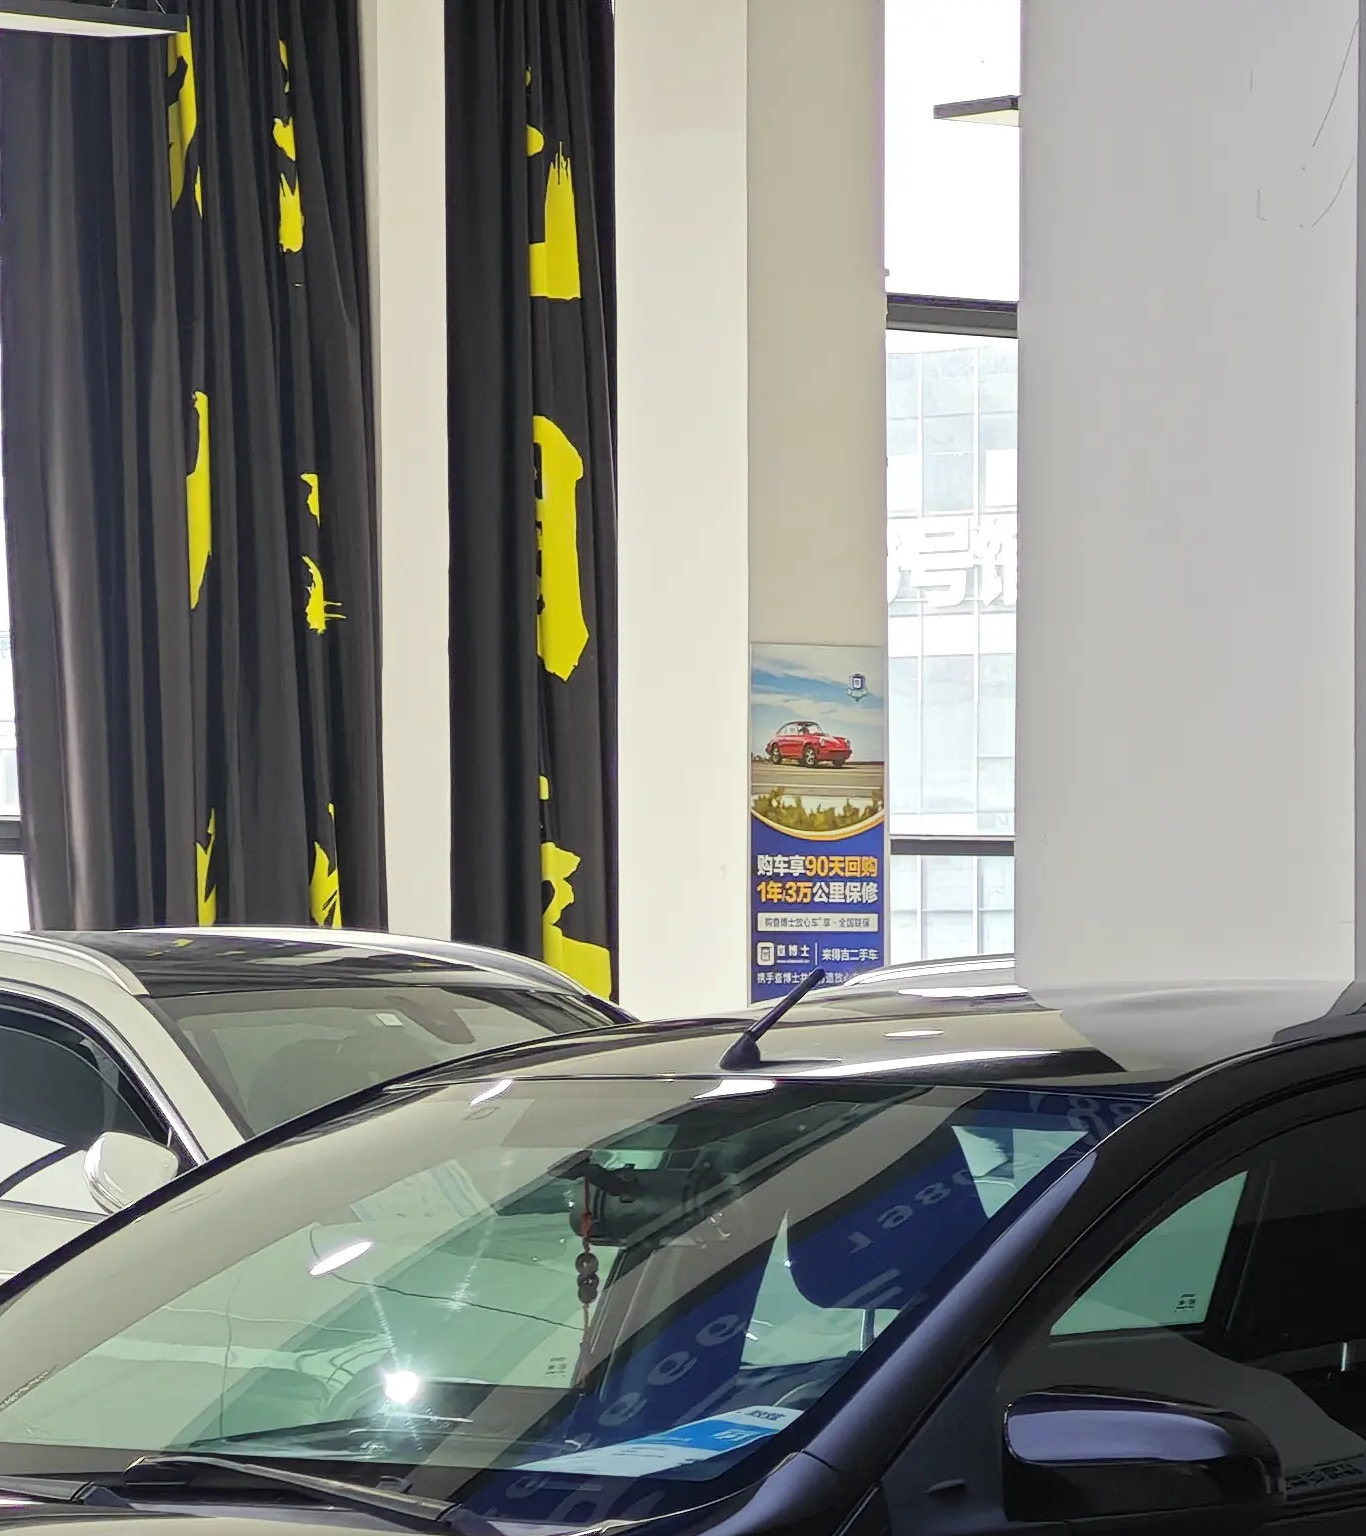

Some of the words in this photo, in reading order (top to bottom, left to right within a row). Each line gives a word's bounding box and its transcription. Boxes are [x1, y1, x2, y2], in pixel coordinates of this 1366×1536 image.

[757, 854, 878, 877] 购车享90天回购
